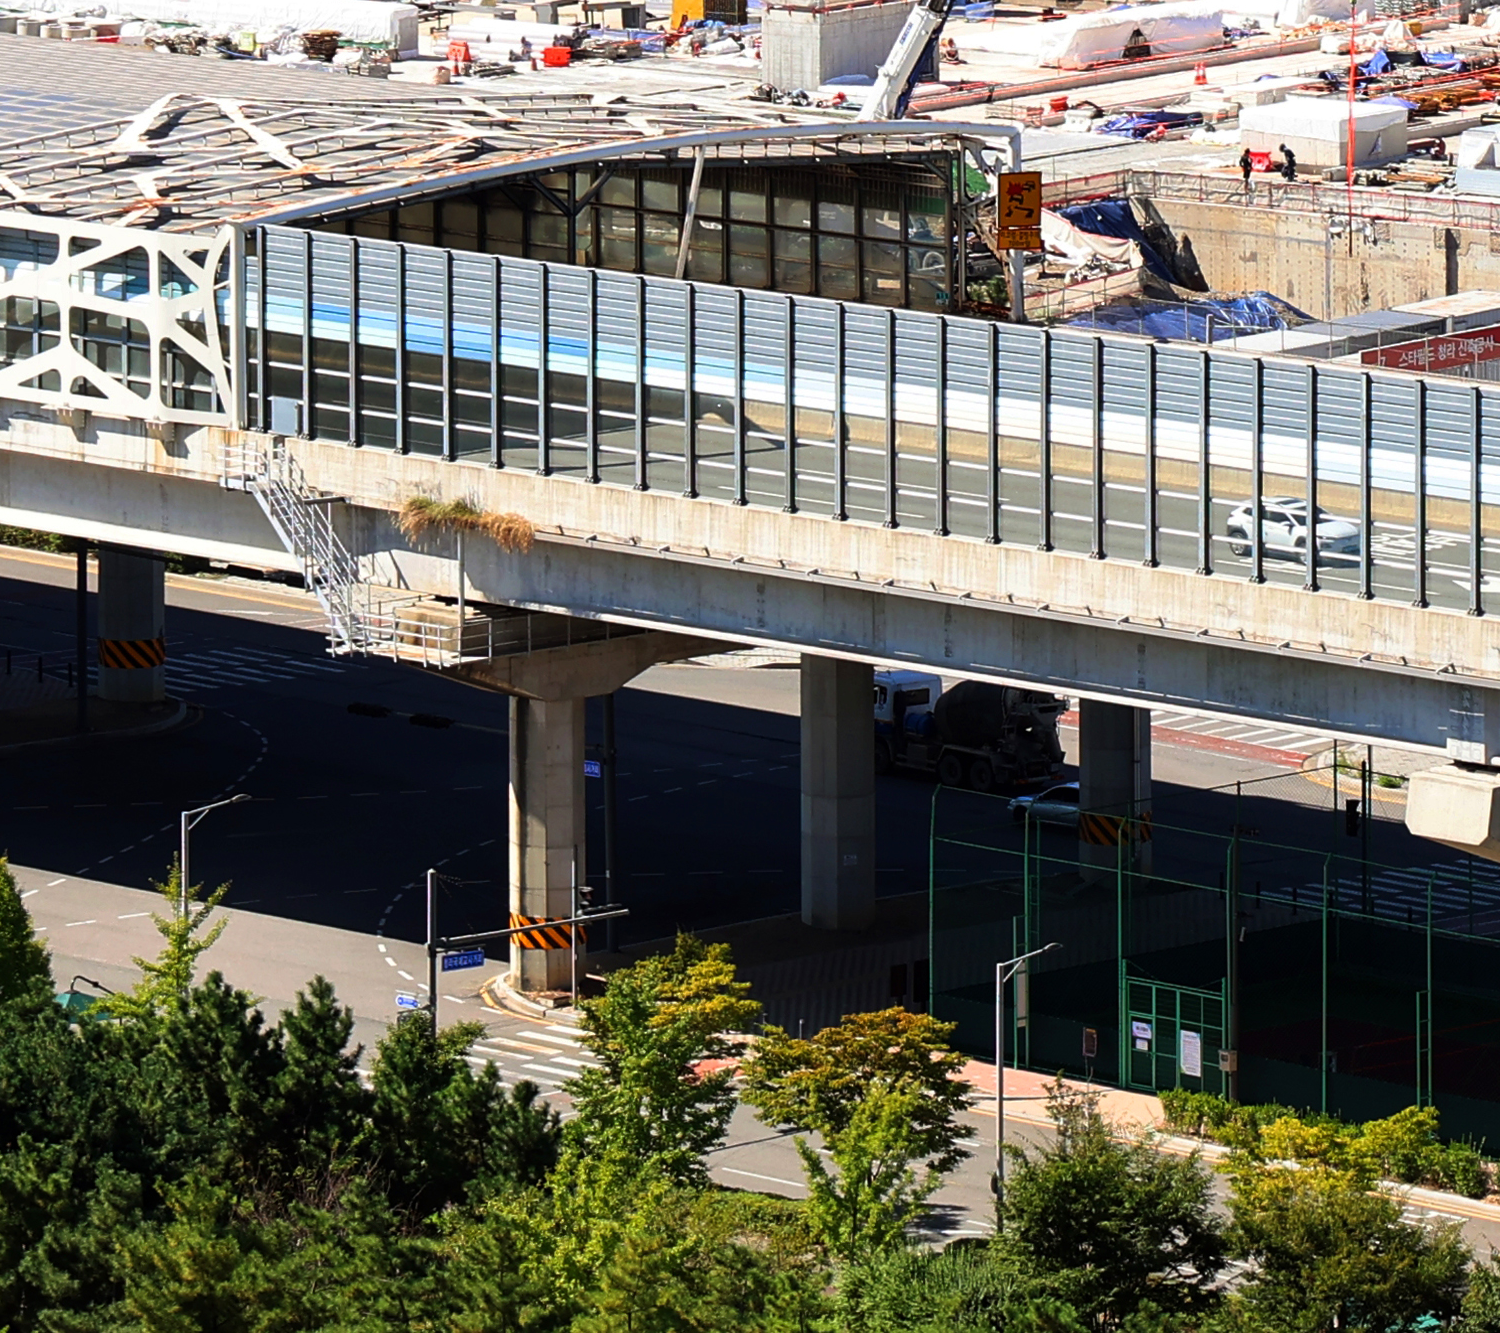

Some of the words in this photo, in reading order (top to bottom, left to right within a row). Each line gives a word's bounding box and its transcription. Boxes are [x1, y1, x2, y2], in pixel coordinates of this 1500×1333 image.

[1398, 346, 1435, 367] 스타필드
[1438, 342, 1456, 361] 청라
[1458, 335, 1494, 356] 신축공사
